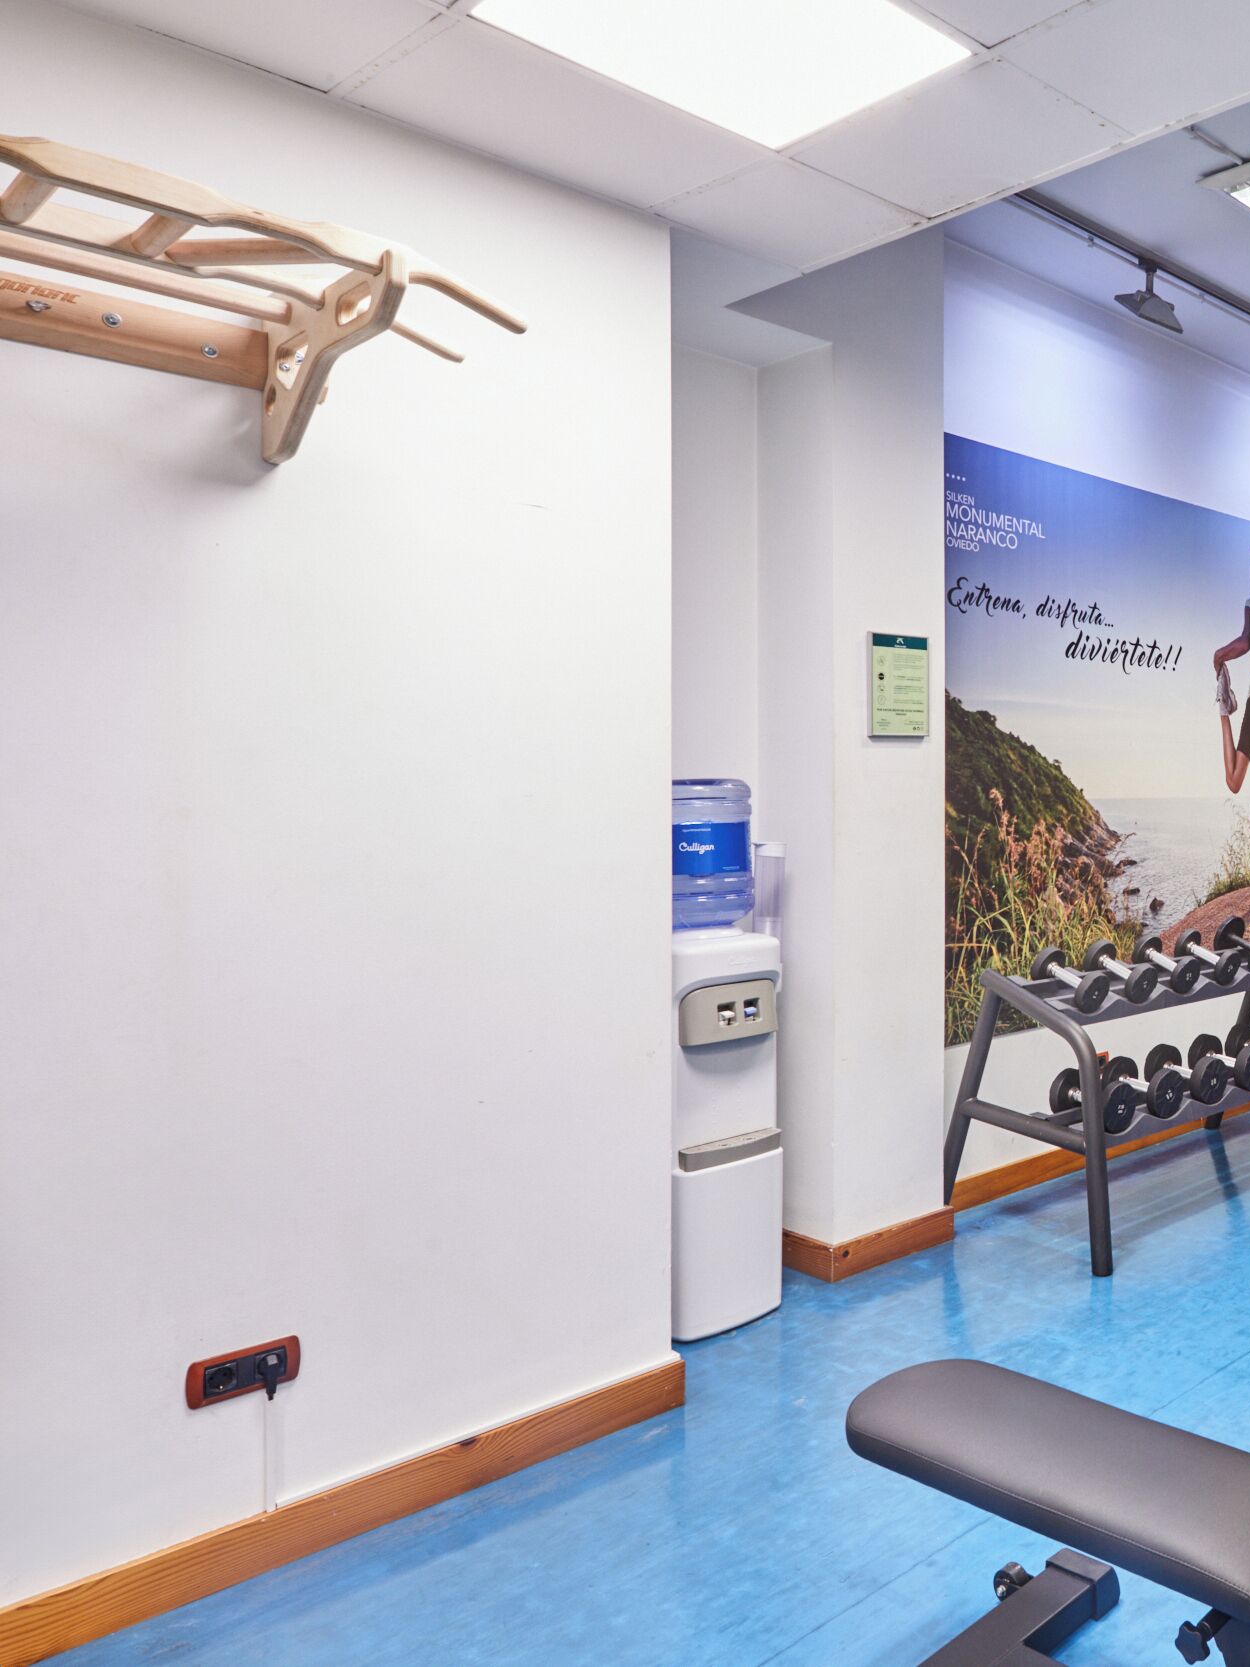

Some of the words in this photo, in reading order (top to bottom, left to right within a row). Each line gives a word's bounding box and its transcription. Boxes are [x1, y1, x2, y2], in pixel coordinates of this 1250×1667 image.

[946, 490, 975, 506] SILKEN
[946, 502, 1046, 539] MONUMENTAL
[946, 520, 1018, 549] NARANCO
[946, 537, 980, 552] OVIEDO
[947, 576, 1026, 619] Entrena,
[1035, 595, 1114, 629] disfruta...
[1065, 630, 1183, 675] diviértete!!
[679, 842, 715, 855] Culligan
